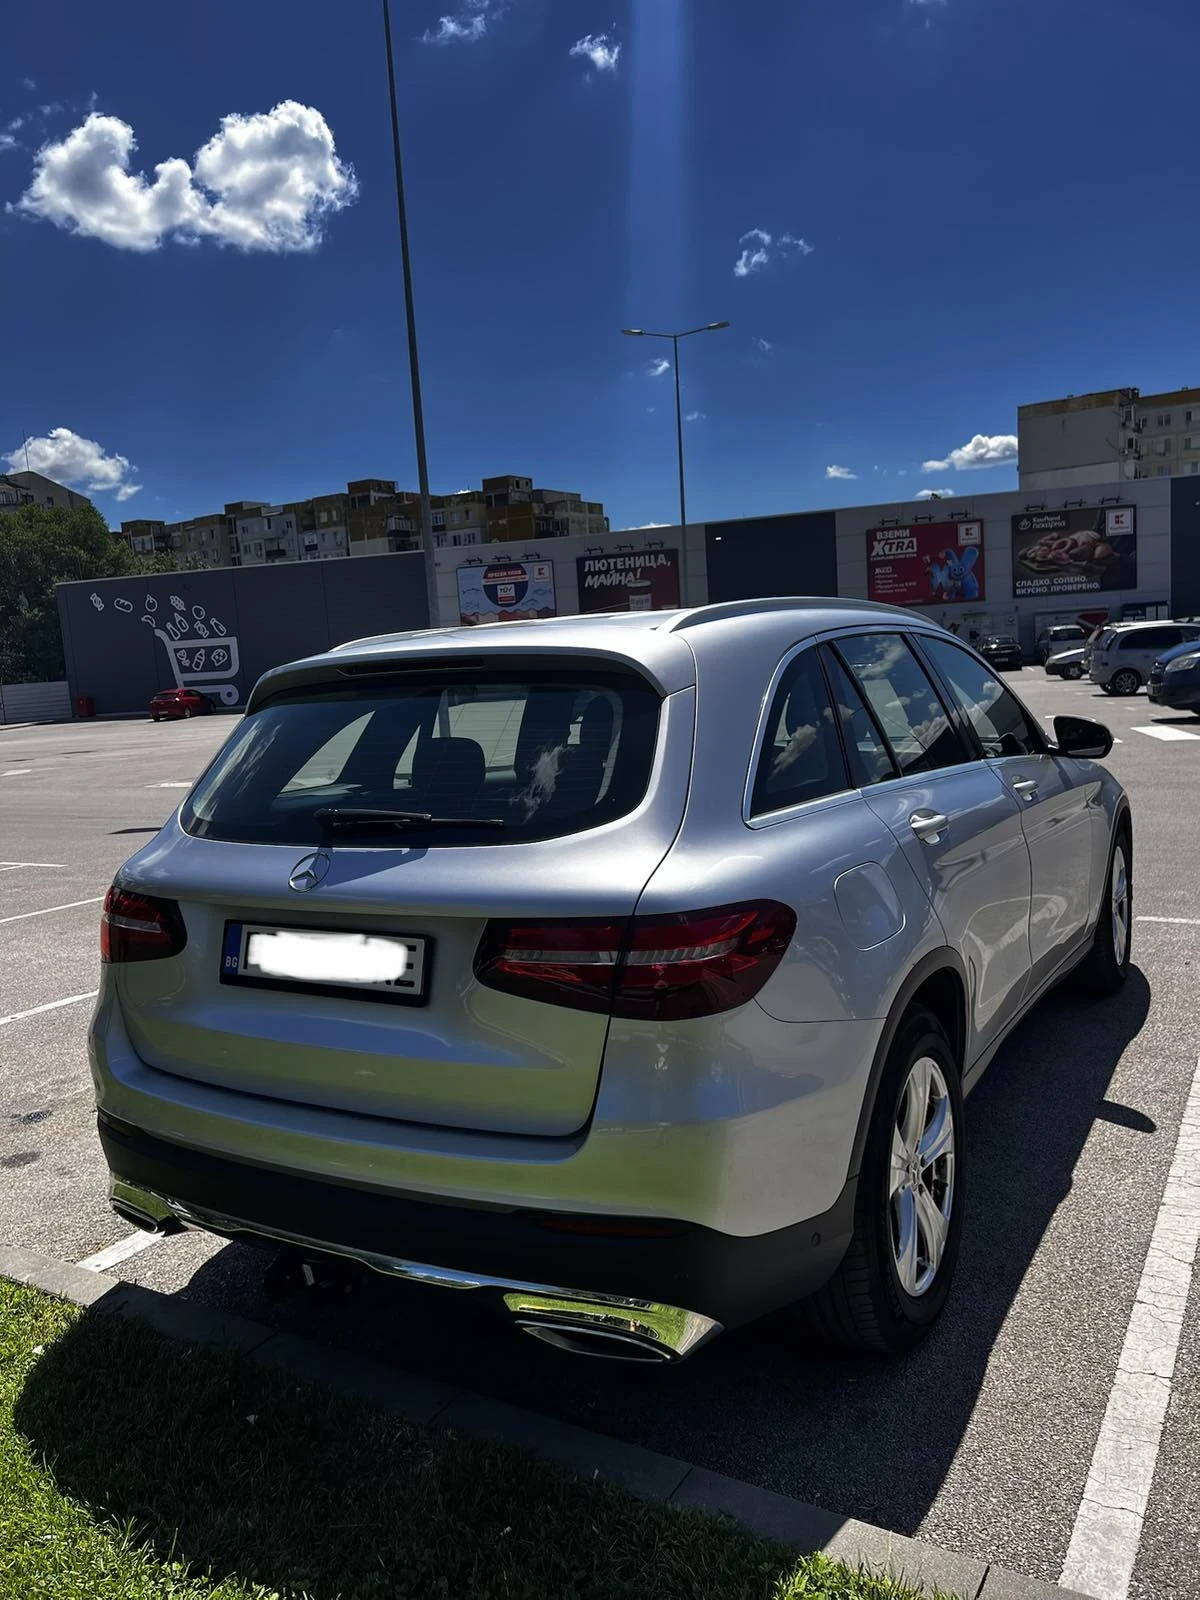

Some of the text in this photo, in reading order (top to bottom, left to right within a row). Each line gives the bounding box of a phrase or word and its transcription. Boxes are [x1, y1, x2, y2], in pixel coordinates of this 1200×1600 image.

[876, 528, 910, 540] ВЗЕМИ
[584, 554, 671, 572] ЛЮТЕНИЦА,
[585, 567, 642, 588] МАЙНА!
[1015, 575, 1087, 588] СЛАДКО. СОЛЕНО.
[1016, 582, 1101, 595] ВКУСНО. ПРОВЕРЕНО.
[225, 955, 238, 968] BG
